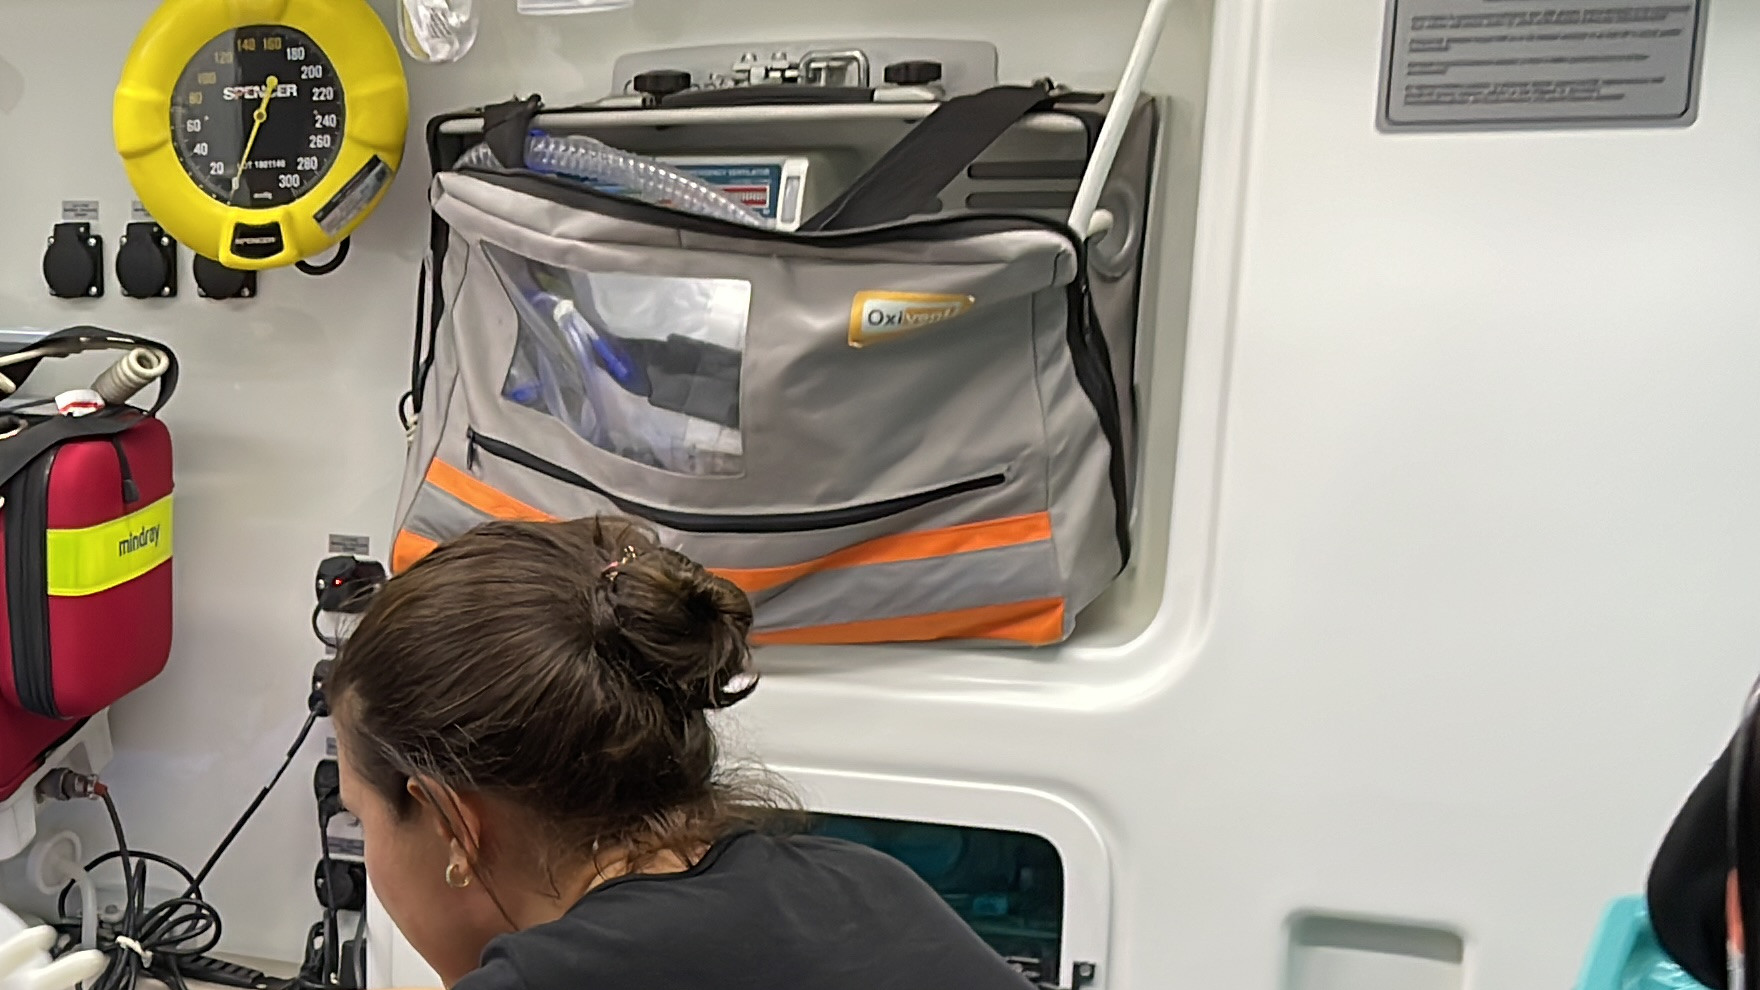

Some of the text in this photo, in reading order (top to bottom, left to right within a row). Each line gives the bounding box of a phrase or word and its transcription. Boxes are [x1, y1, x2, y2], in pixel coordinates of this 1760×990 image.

[238, 38, 256, 50] 140
[215, 52, 233, 64] 120
[287, 47, 305, 60] 180
[301, 65, 322, 79] 200
[312, 87, 334, 100] 220
[187, 120, 201, 132] 60
[315, 115, 336, 128] 240
[309, 135, 330, 148] 260
[193, 143, 208, 155] 40
[210, 162, 224, 175] 20
[297, 157, 318, 170] 280
[279, 174, 300, 188] 300
[118, 524, 160, 557] mindray
